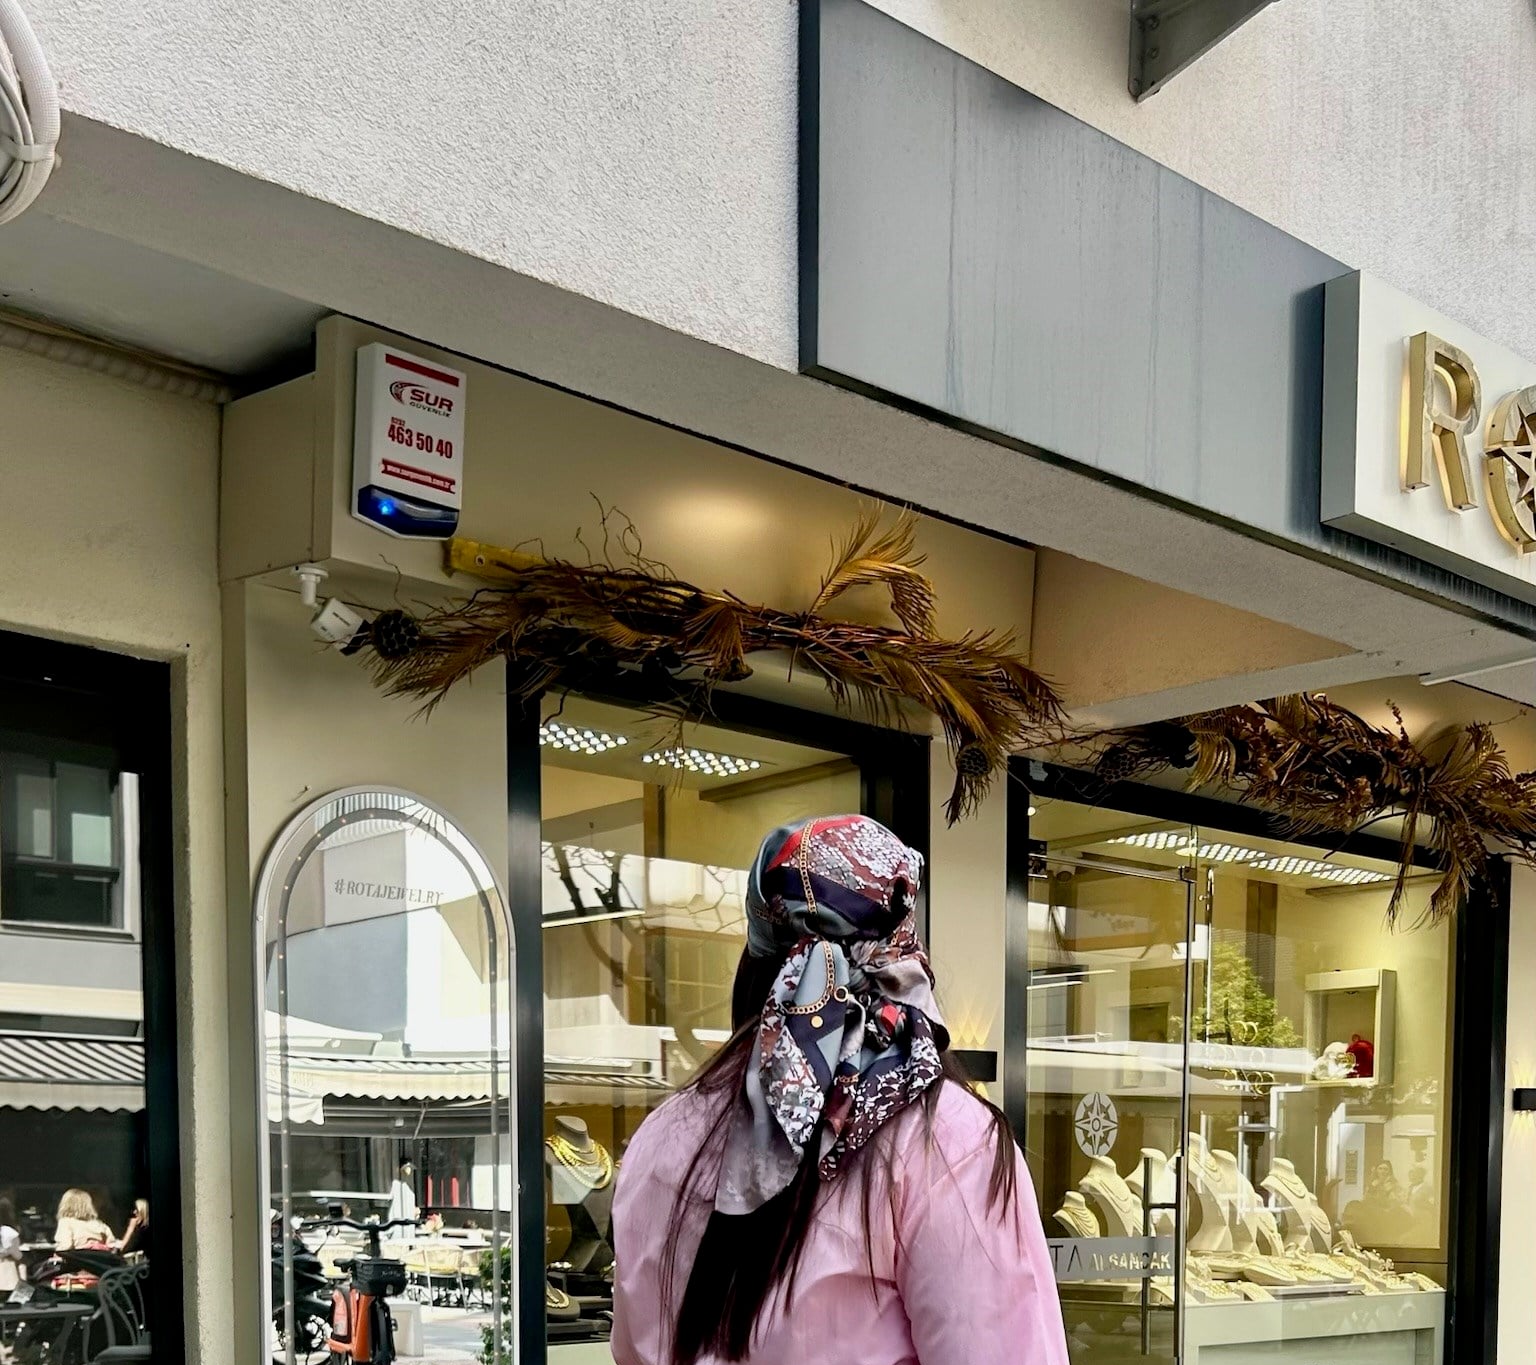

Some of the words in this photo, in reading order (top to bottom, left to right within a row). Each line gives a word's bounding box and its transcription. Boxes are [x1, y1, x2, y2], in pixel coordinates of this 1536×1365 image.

[410, 389, 453, 412] SUR
[388, 424, 413, 447] 463
[416, 432, 433, 453] 50
[436, 439, 453, 459] 40
